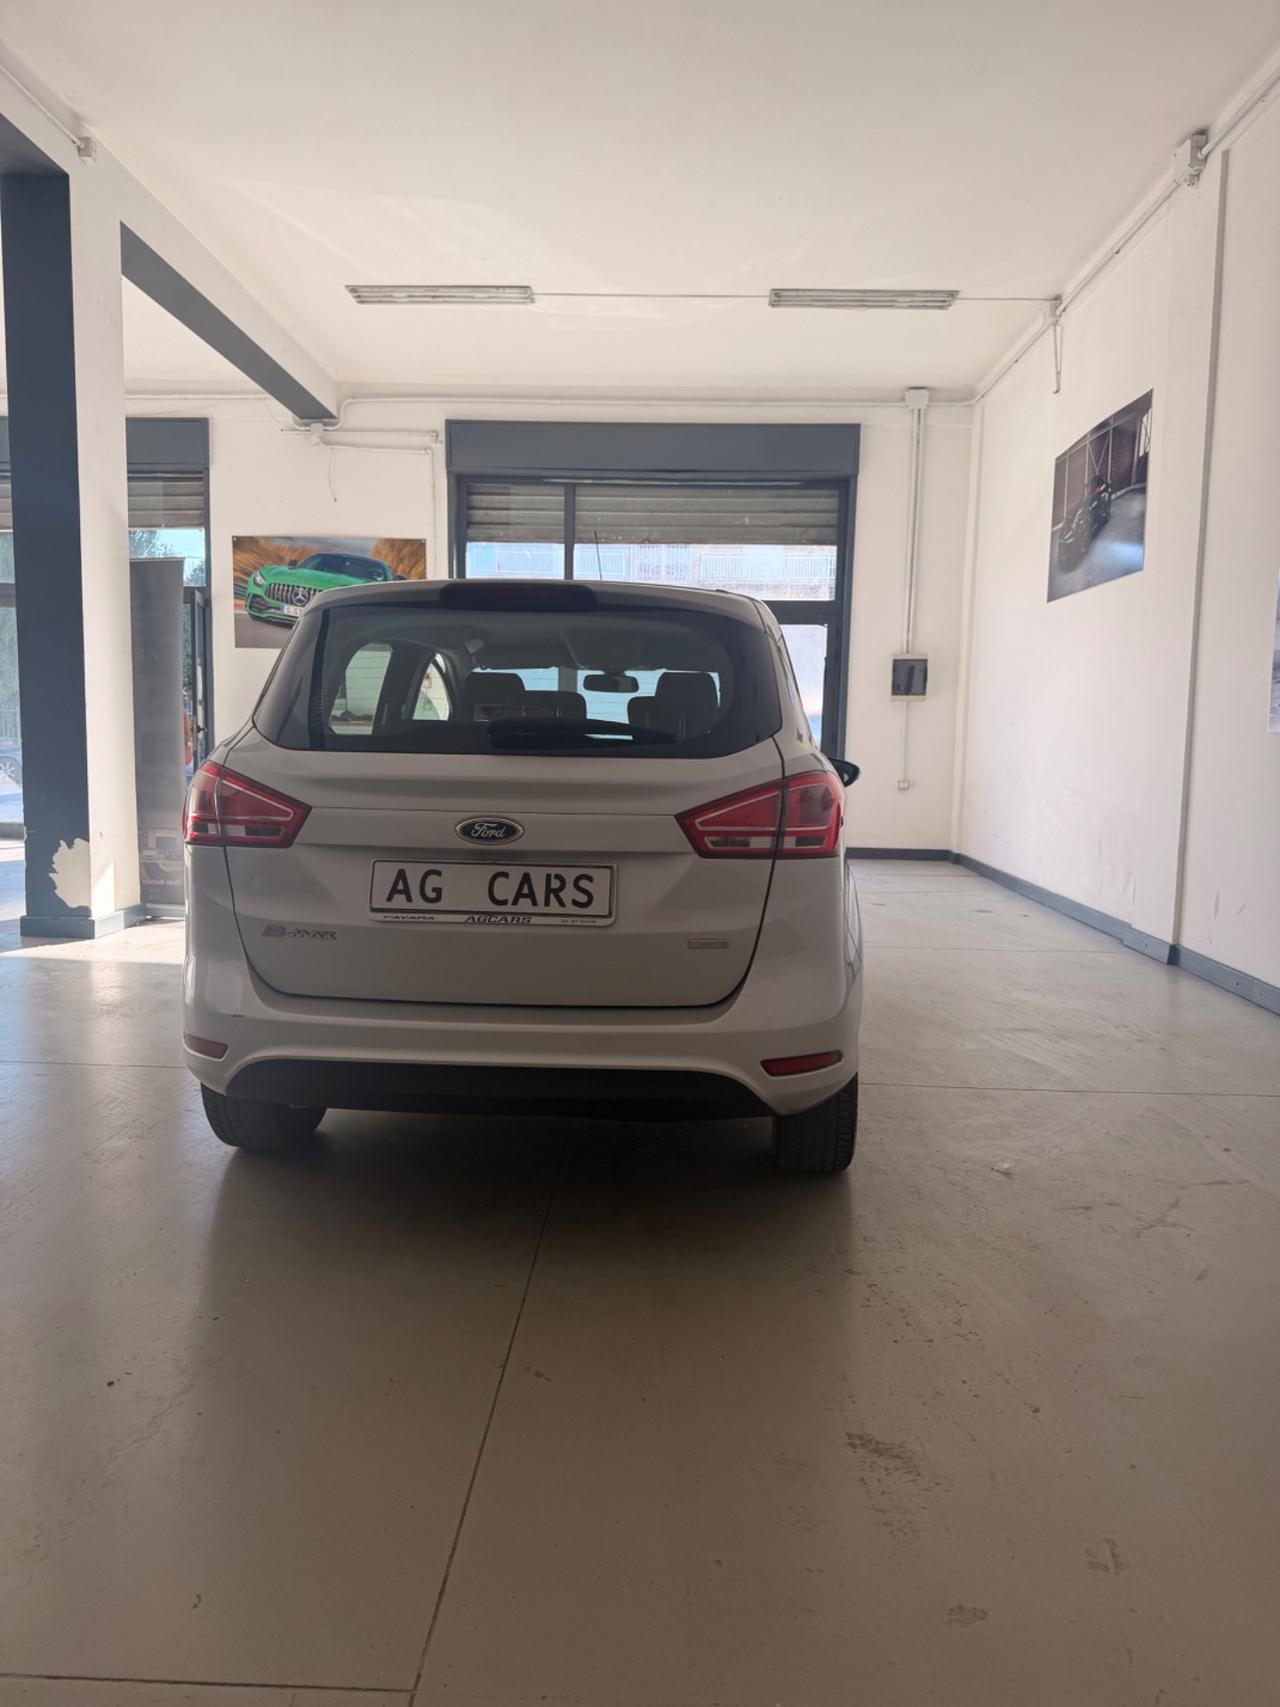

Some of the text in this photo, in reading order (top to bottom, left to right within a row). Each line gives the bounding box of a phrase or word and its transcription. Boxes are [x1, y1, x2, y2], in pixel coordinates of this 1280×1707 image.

[471, 822, 505, 838] Ford
[385, 868, 594, 909] AG CARS
[463, 914, 533, 924] AGCARS
